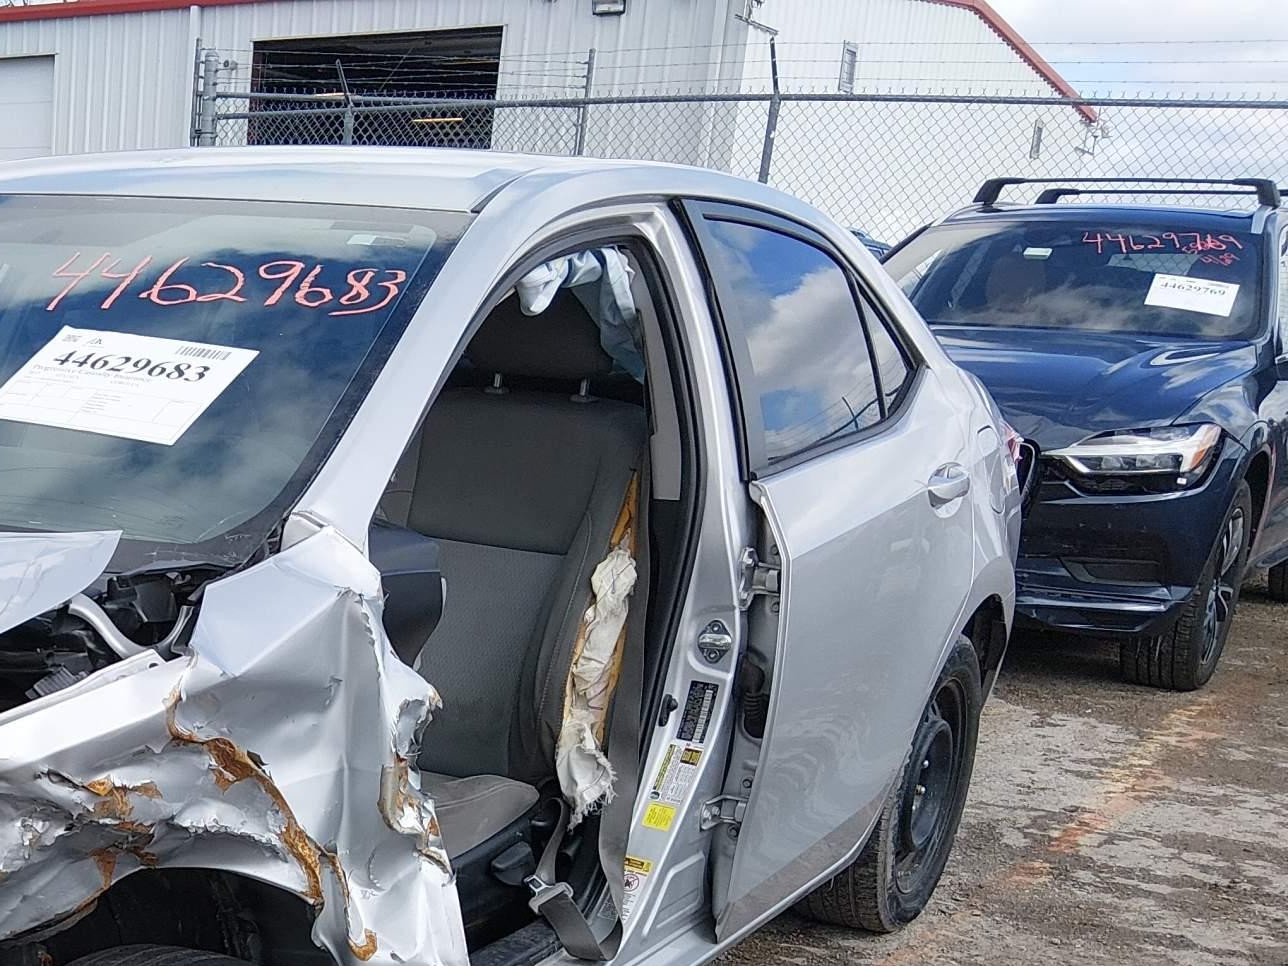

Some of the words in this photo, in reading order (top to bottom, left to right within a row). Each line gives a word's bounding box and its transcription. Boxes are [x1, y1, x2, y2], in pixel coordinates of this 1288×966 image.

[46, 252, 407, 316] 44629683
[1160, 281, 1227, 296] 44629769
[52, 350, 210, 382] 44629683
